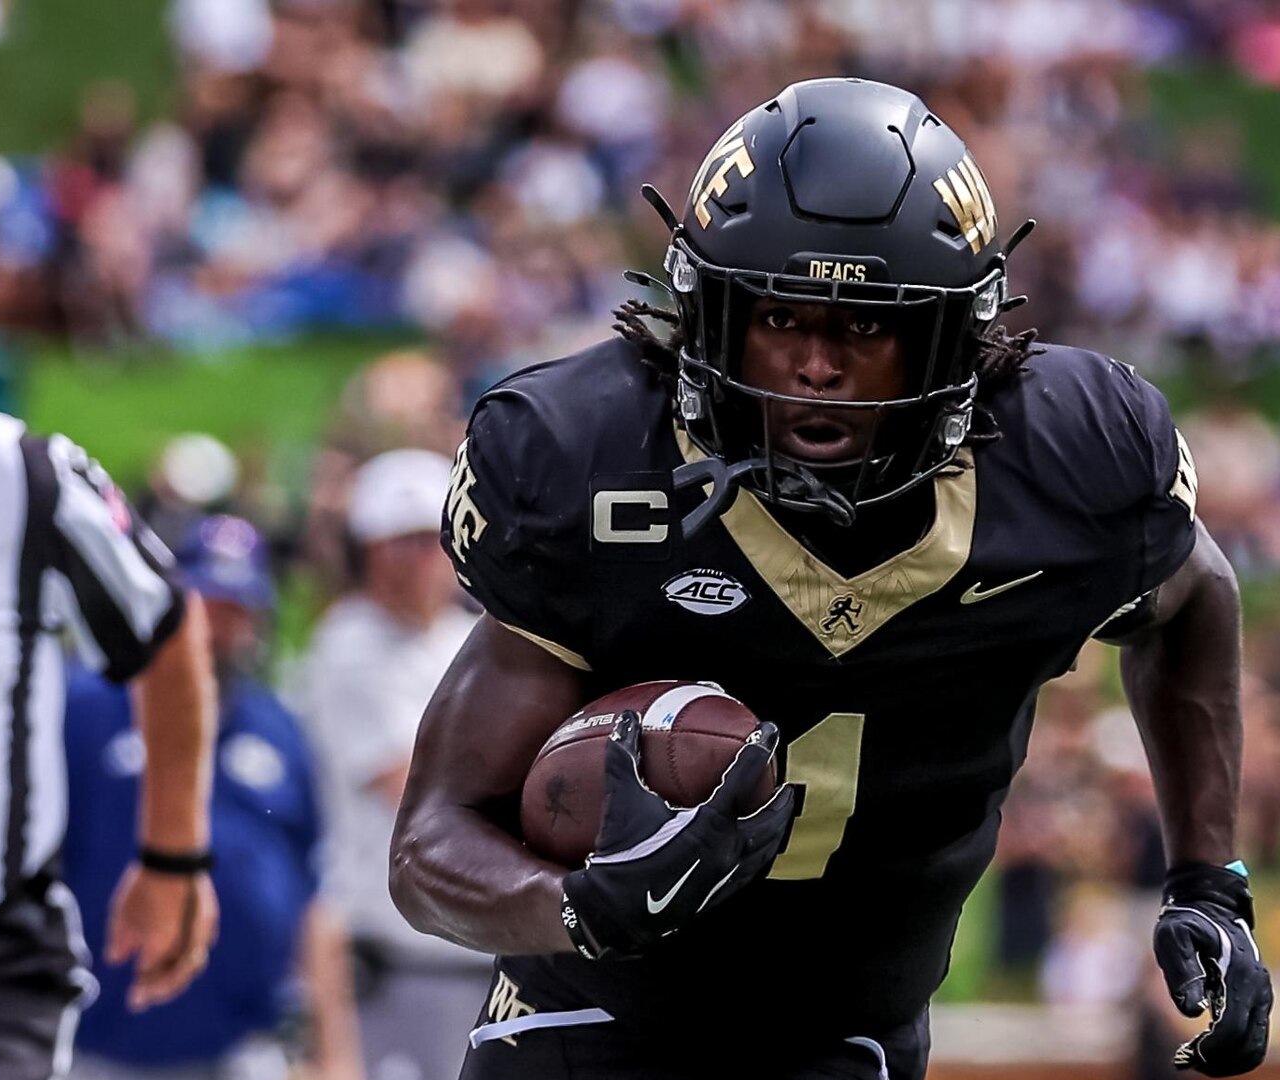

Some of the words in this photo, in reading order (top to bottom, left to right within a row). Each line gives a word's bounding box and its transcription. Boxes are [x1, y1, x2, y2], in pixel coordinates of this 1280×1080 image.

[809, 260, 867, 282] DEACS
[593, 490, 669, 543] C
[674, 581, 739, 601] ACC
[766, 712, 866, 880] 1
